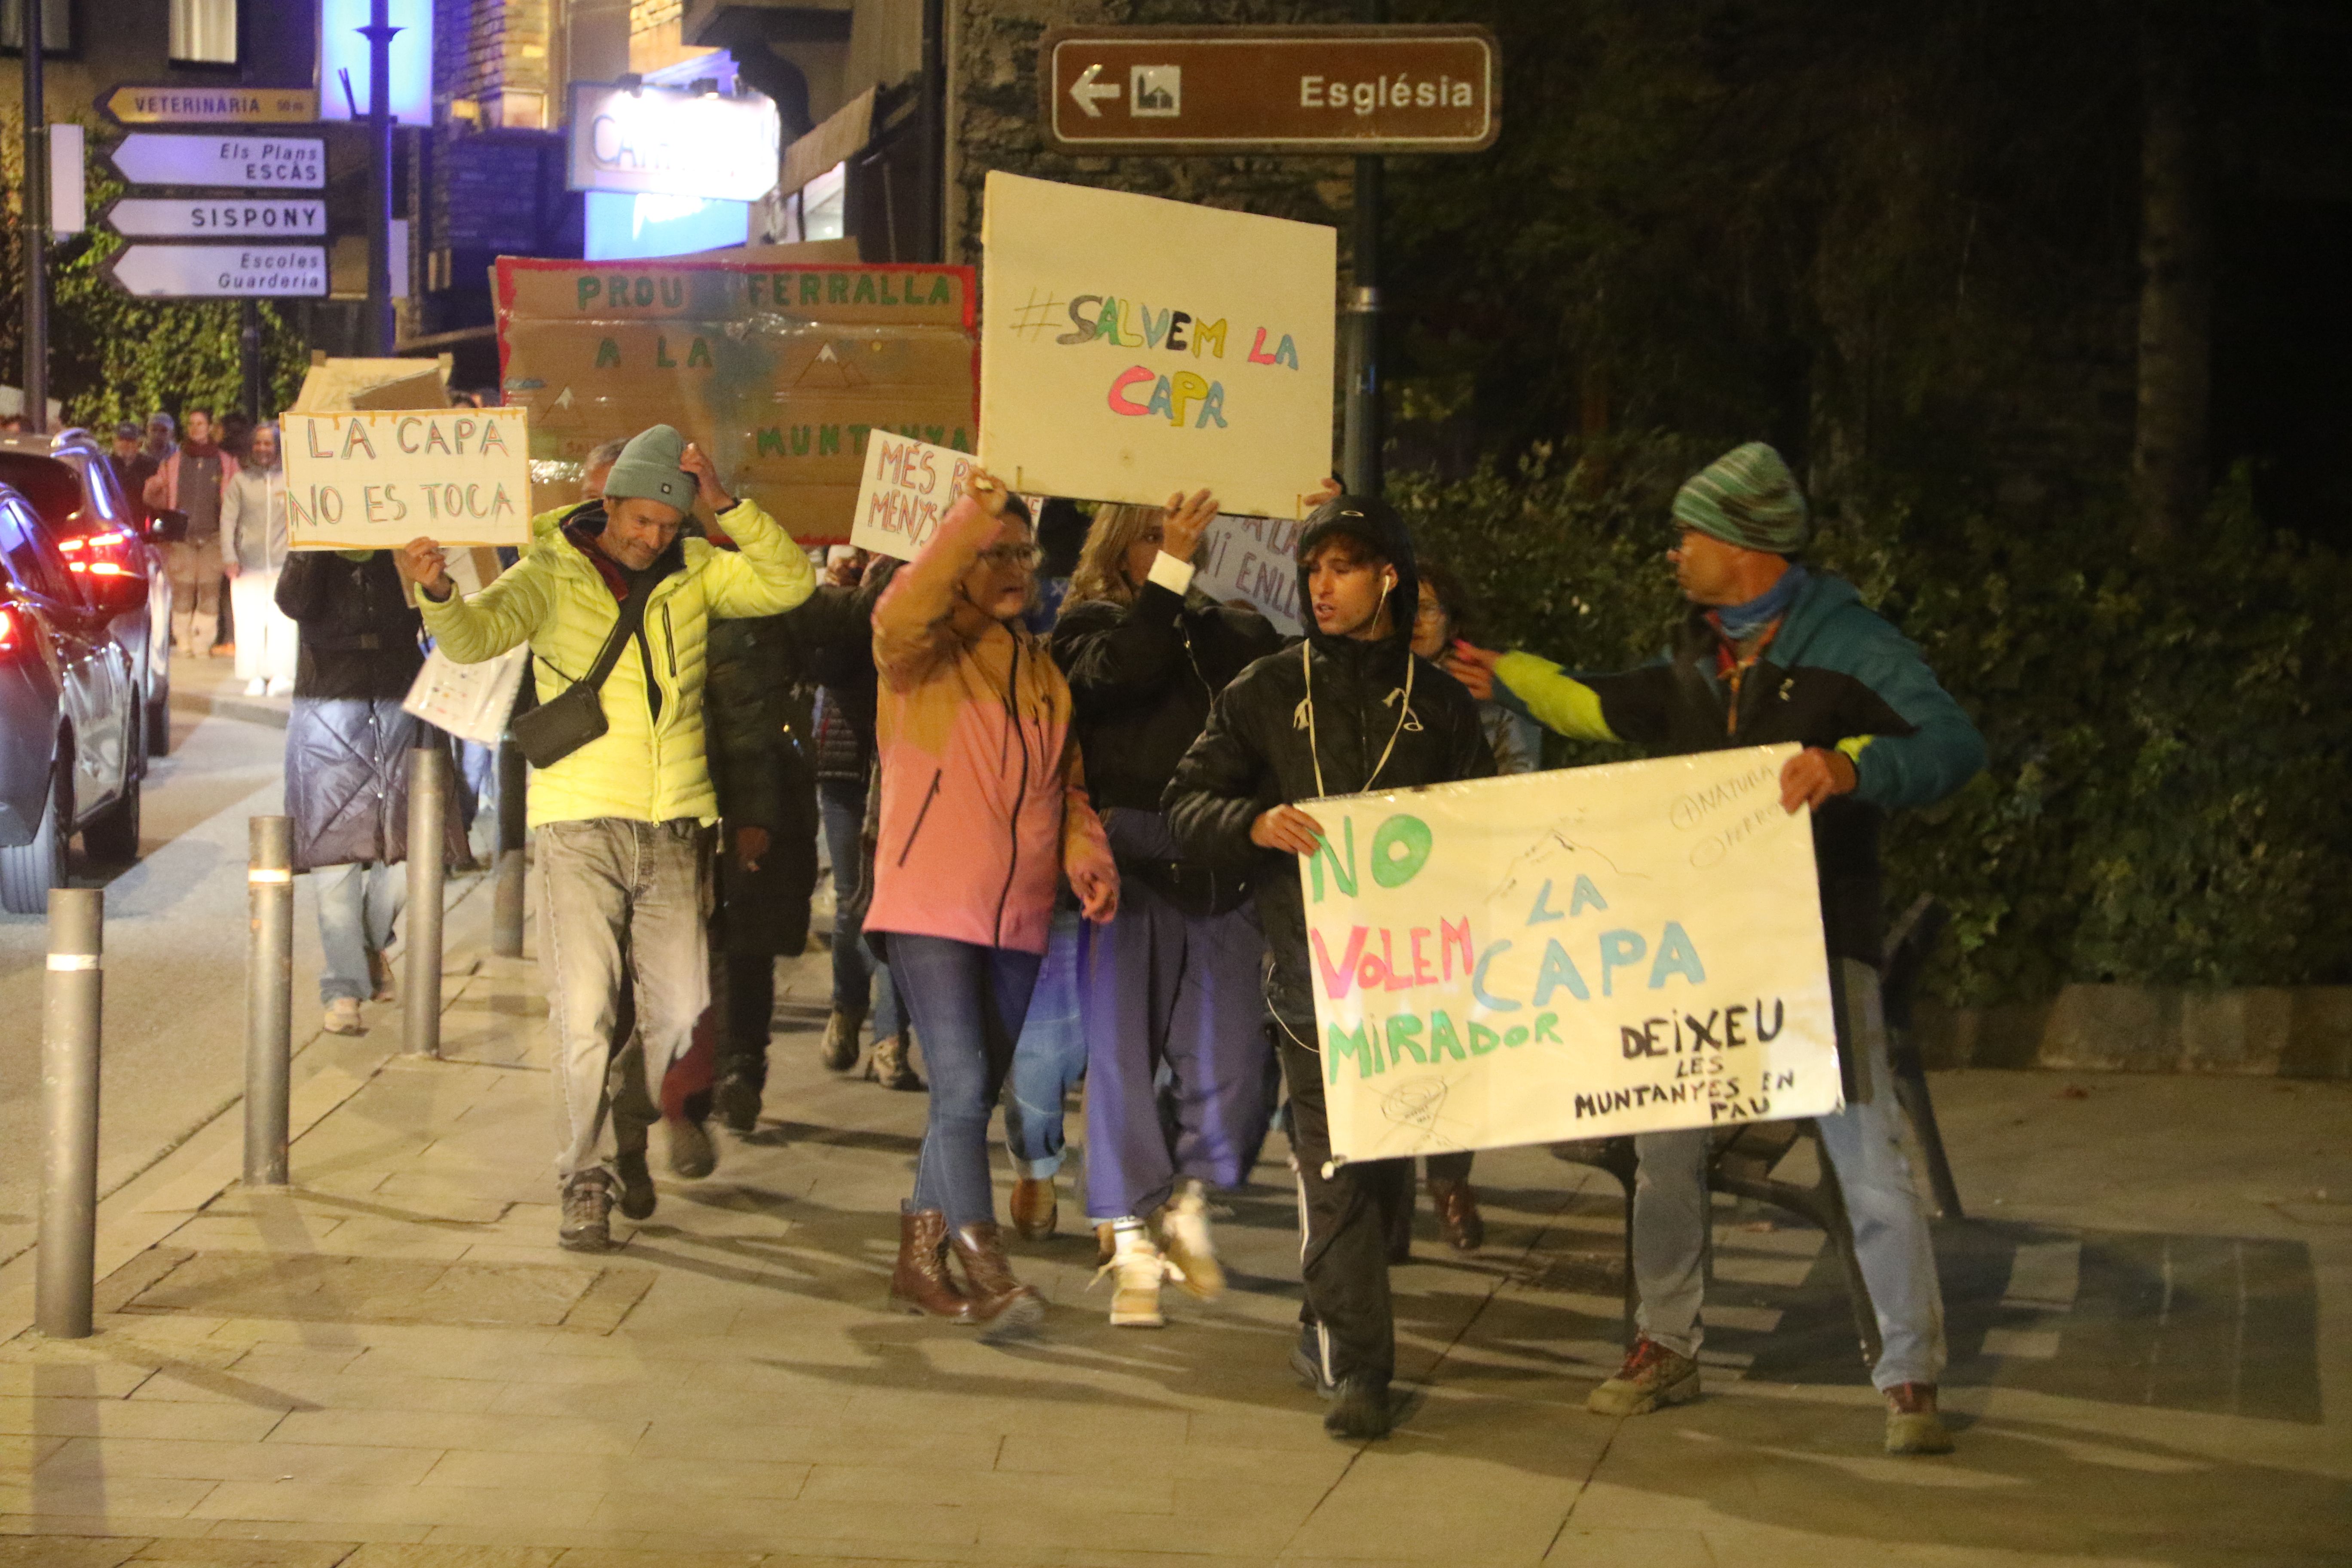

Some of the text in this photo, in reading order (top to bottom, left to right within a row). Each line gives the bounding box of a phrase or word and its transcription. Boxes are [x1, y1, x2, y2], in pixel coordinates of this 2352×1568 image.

[1300, 72, 1473, 115] Església
[220, 143, 316, 161] Els Plans
[192, 208, 315, 227] SISPONY
[240, 253, 318, 269] Escoles
[577, 273, 950, 310] PROU FERRALLA
[1010, 286, 1299, 371] #SALVEM LA
[595, 335, 712, 369] A LA
[1108, 365, 1228, 429] CAPA
[308, 416, 510, 459] LA CAPA
[876, 440, 936, 494] MÉS
[289, 482, 516, 528] NO ES TOCA
[867, 489, 938, 547] MENYS
[1308, 813, 1432, 904] NO
[1526, 873, 1608, 926] LA
[1311, 916, 1706, 1011] VOLEM CAPA
[1675, 1056, 1723, 1079] LES
[1574, 1069, 1794, 1119] MUNTANYES EN
[1710, 1095, 1771, 1121] PAU
